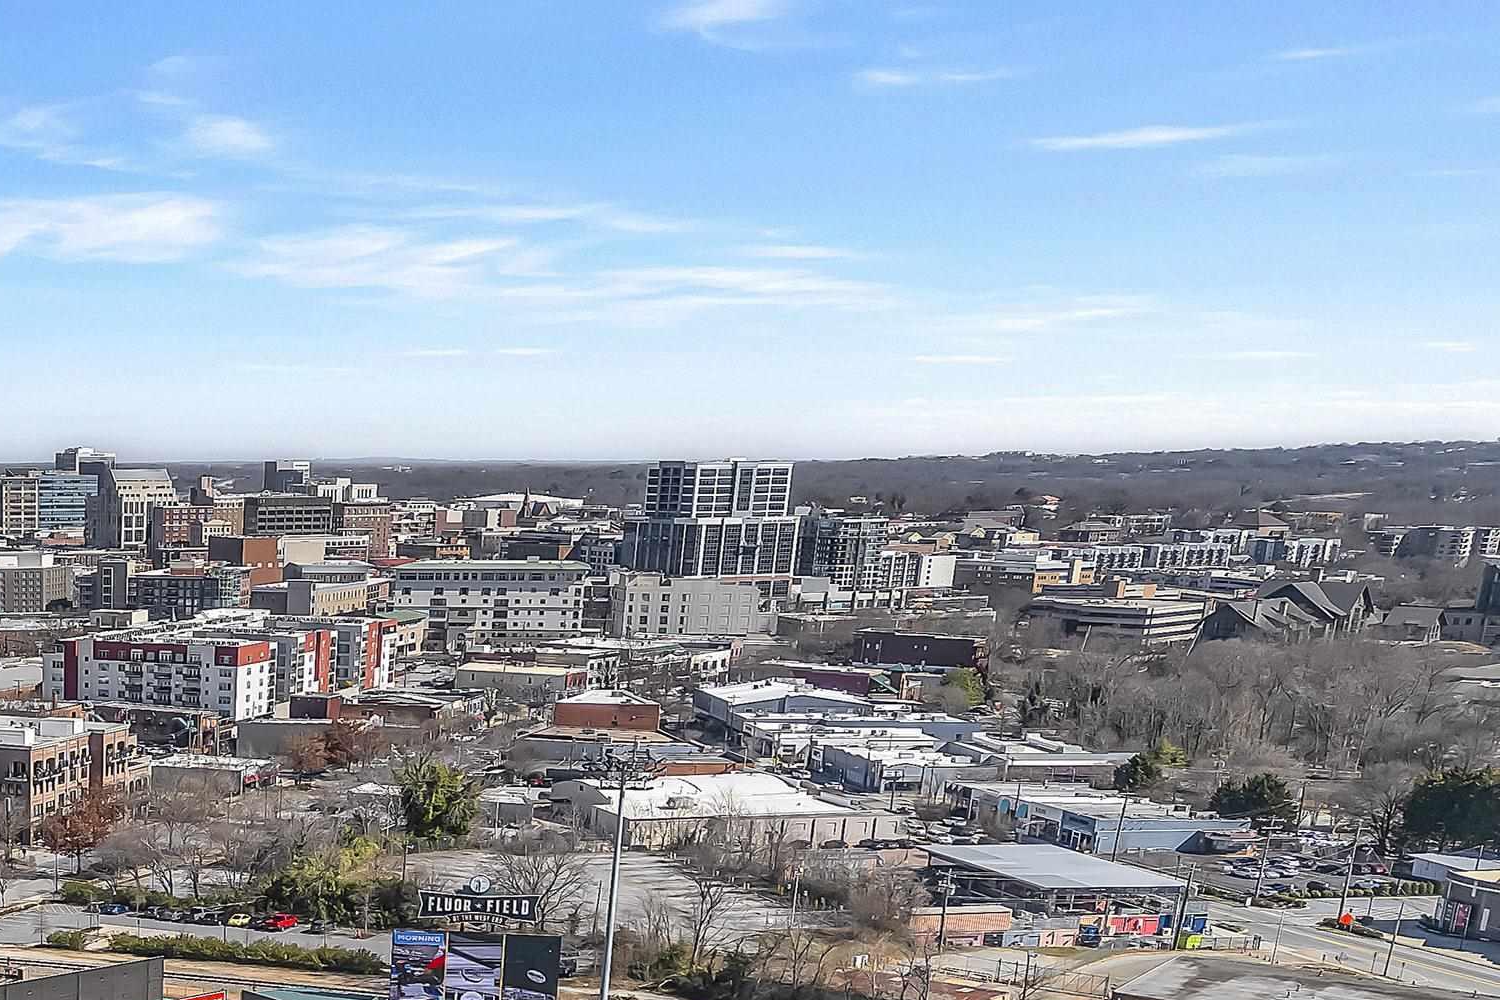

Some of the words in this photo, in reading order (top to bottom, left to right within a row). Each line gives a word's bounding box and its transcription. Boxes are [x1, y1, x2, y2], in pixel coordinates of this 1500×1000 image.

[427, 896, 471, 912] FLUOR
[486, 899, 530, 915] FIELD
[396, 934, 441, 943] MORNING
